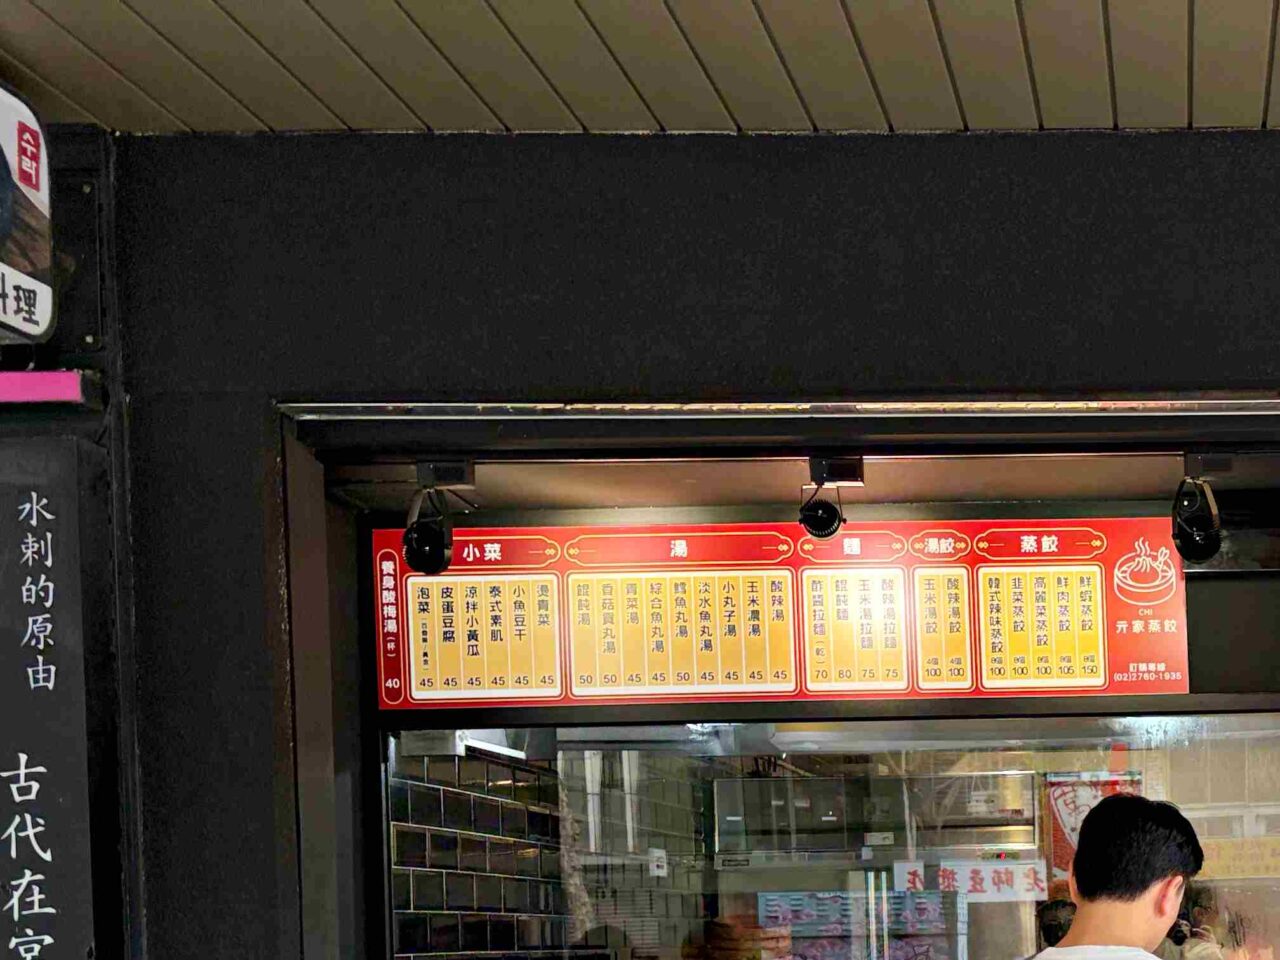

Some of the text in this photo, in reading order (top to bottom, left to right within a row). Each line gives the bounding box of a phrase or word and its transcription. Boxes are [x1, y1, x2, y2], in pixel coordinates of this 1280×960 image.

[670, 539, 688, 558] 湯
[923, 537, 955, 554] 湯餃
[1020, 534, 1059, 553] 蒸餃
[462, 542, 502, 561] 小菜
[576, 584, 591, 625] 餛飩湯
[626, 583, 640, 625] 青菜湯
[770, 580, 785, 622] 酸辣湯
[923, 578, 938, 634] 玉米湯餃
[946, 577, 962, 634] 酸辣湯餃
[1011, 576, 1026, 632] 韭菜蒸餃
[1056, 576, 1071, 632] 鮮肉蒸餃
[1079, 575, 1093, 632] 鮮蝦蒸餃
[489, 585, 503, 642] 泰式素肌
[513, 585, 527, 642] 小魚豆干
[722, 581, 737, 637] 小丸子湯
[747, 580, 761, 637] 玉米濃湯
[1033, 576, 1049, 647] 高麗菜蒸餃
[1138, 608, 1153, 616] CHI
[440, 586, 456, 643] 皮蛋豆腐
[601, 584, 616, 654] 香菇貢丸湯
[649, 582, 664, 653] 綜合魚丸湯
[698, 581, 713, 652] 淡水魚丸湯
[988, 576, 1004, 654] 韓式辣味蒸餃
[464, 585, 480, 657] 涼拌小黃瓜
[724, 671, 739, 680] 45
[748, 670, 763, 680] 45
[773, 670, 787, 679] 45
[815, 669, 828, 679] 70
[837, 669, 852, 679] 80
[861, 669, 875, 678] 75
[885, 668, 898, 678] 75
[925, 667, 942, 677] 100
[948, 667, 965, 677] 100
[989, 666, 1006, 676] 100
[1011, 666, 1028, 675] 100
[1035, 666, 1052, 675] 100
[1057, 665, 1075, 675] 105
[1081, 665, 1097, 675] 150
[467, 676, 482, 687] 45
[491, 676, 506, 686] 45
[514, 675, 529, 686] 45
[540, 675, 554, 685] 45
[579, 674, 593, 685] 50
[603, 674, 617, 684] 50
[627, 673, 642, 683] 45
[651, 672, 666, 682] 45
[676, 672, 690, 681] 50
[700, 671, 715, 681] 45
[385, 678, 400, 689] 40
[419, 678, 434, 688] 45
[443, 677, 458, 687] 45
